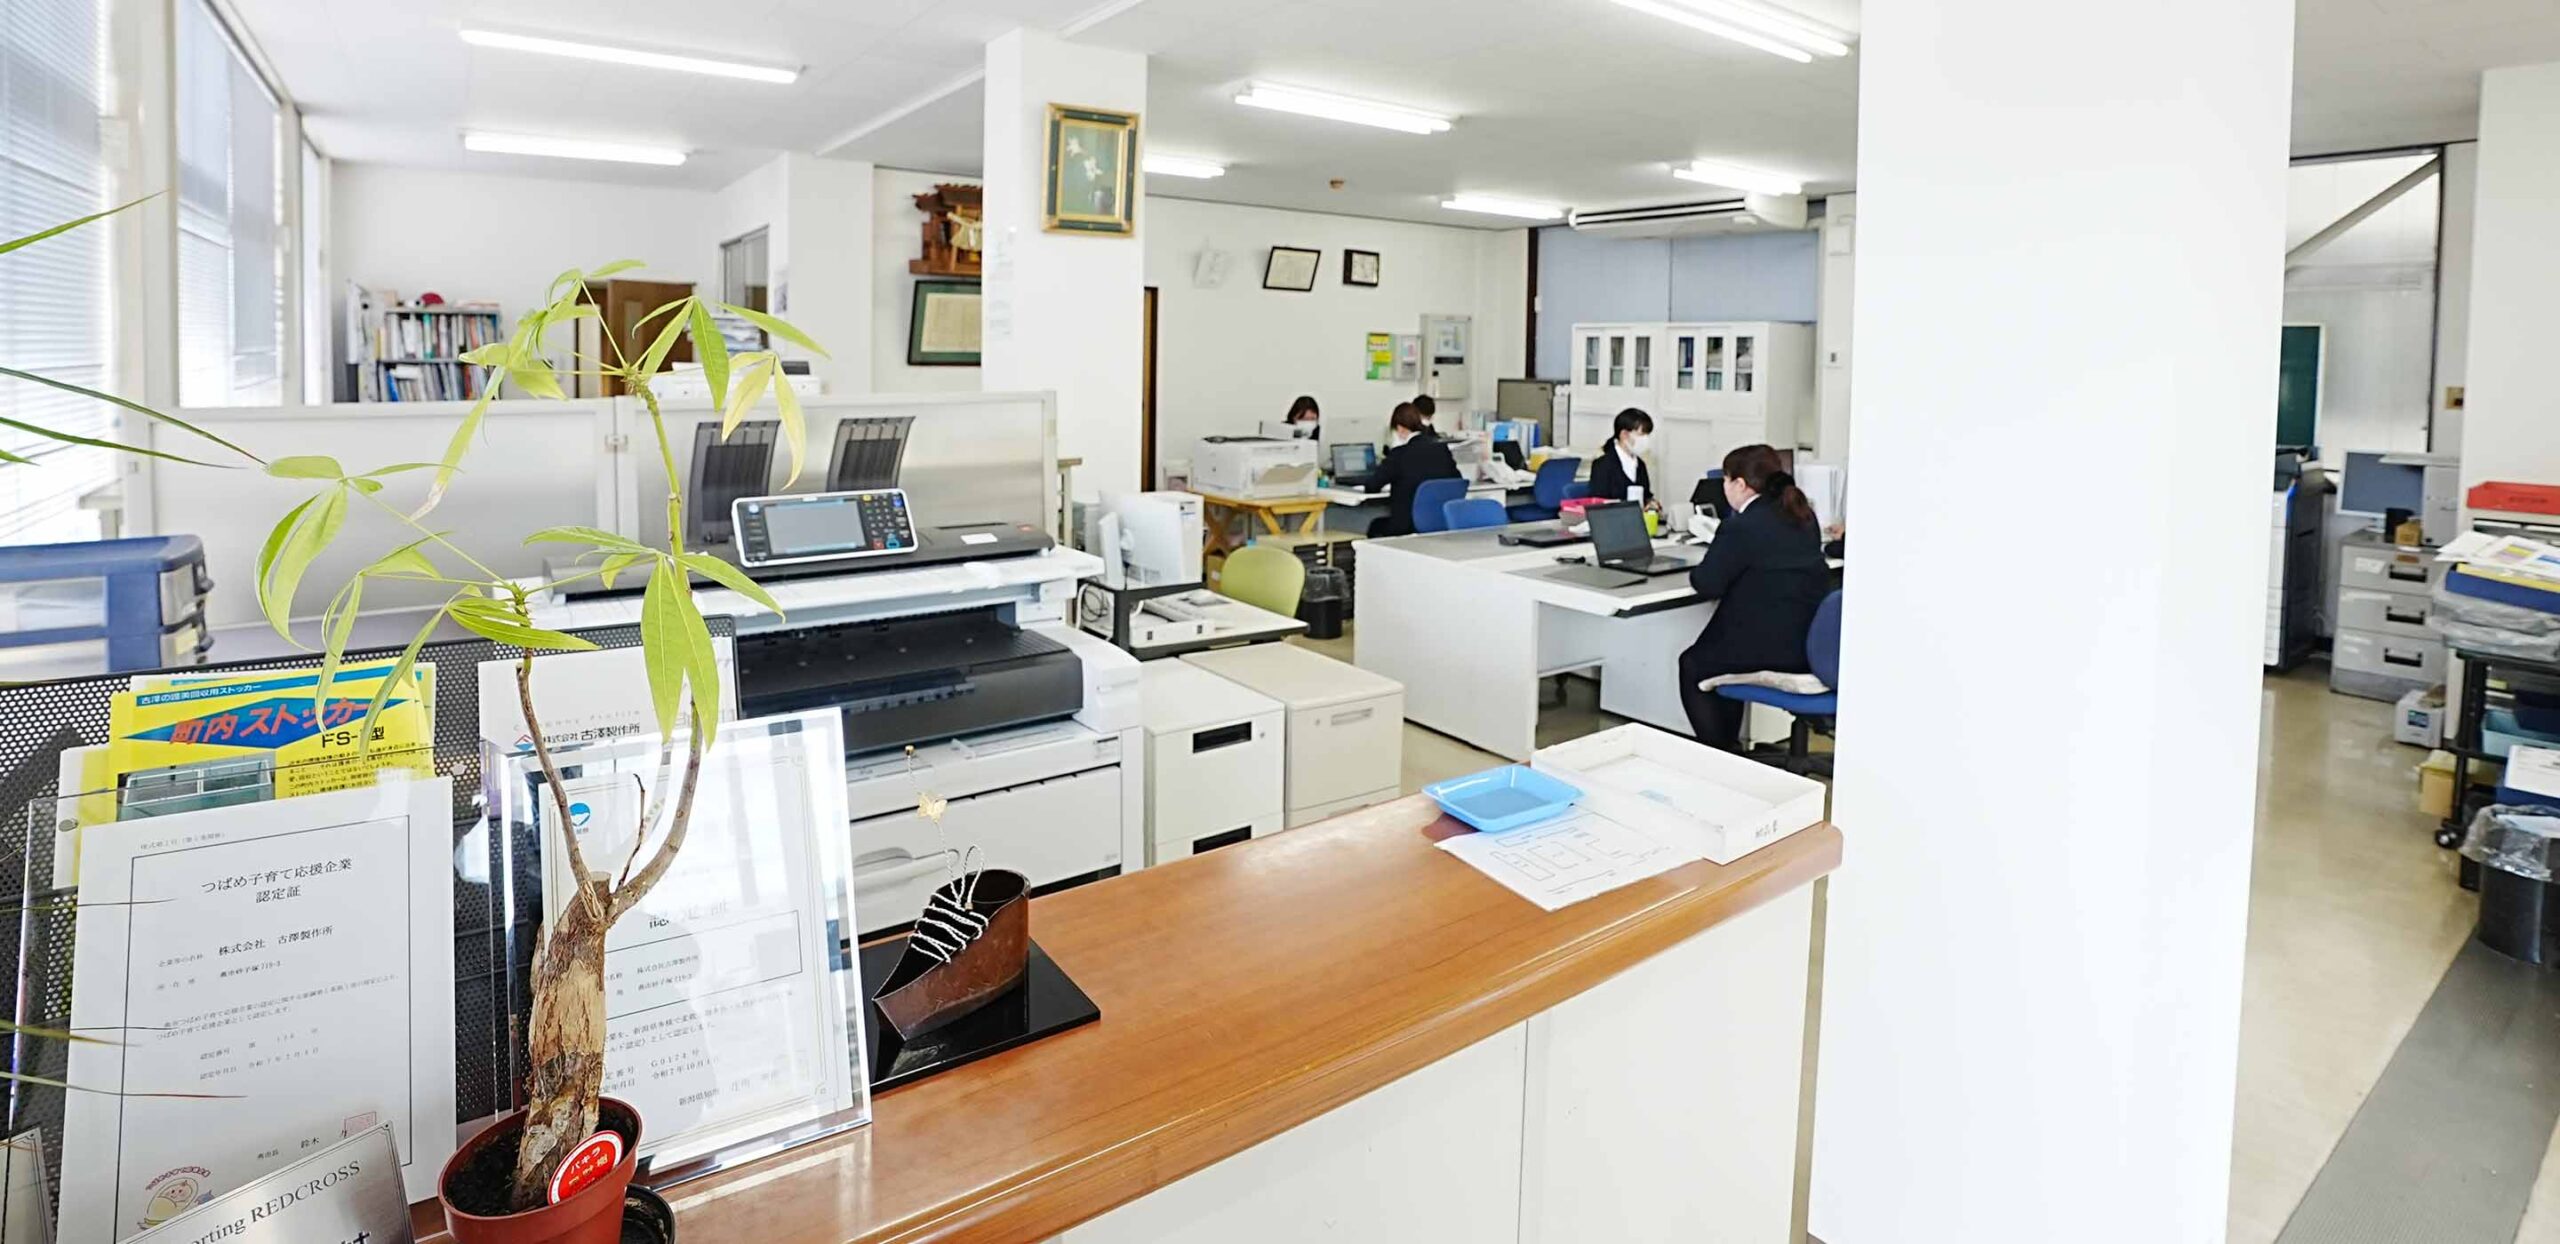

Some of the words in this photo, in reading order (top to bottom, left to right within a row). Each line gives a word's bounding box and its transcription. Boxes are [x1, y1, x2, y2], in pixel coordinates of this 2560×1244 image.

[322, 726, 385, 749] FS-型
[201, 858, 353, 894] つばめ子育て応援企業
[255, 885, 302, 904] 認定証
[218, 938, 266, 957] 株式会社
[277, 924, 334, 946] 古澤製作所
[570, 1146, 602, 1174] パキラ
[250, 1159, 361, 1223] REDCROSS
